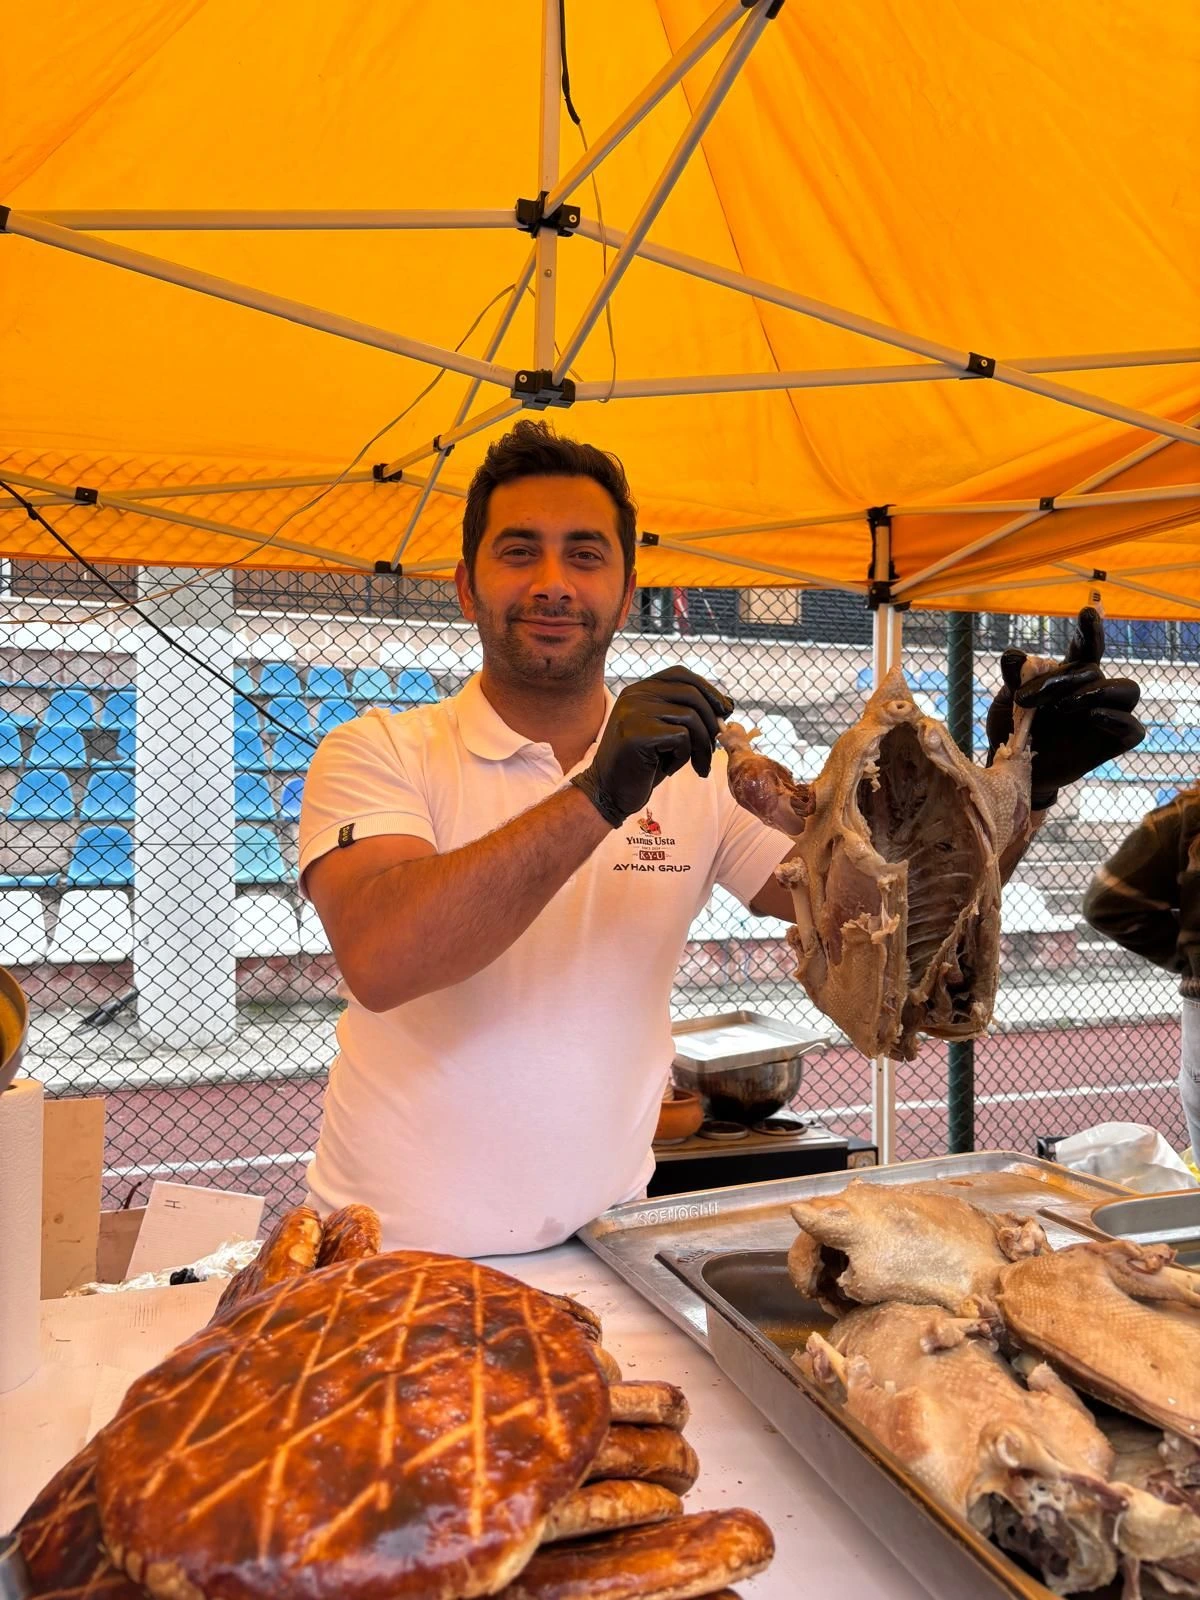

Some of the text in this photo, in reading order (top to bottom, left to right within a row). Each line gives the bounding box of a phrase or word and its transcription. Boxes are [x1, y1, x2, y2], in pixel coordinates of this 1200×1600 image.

[626, 836, 675, 846] Yunus Usta
[613, 863, 691, 873] AYHAN GRUP
